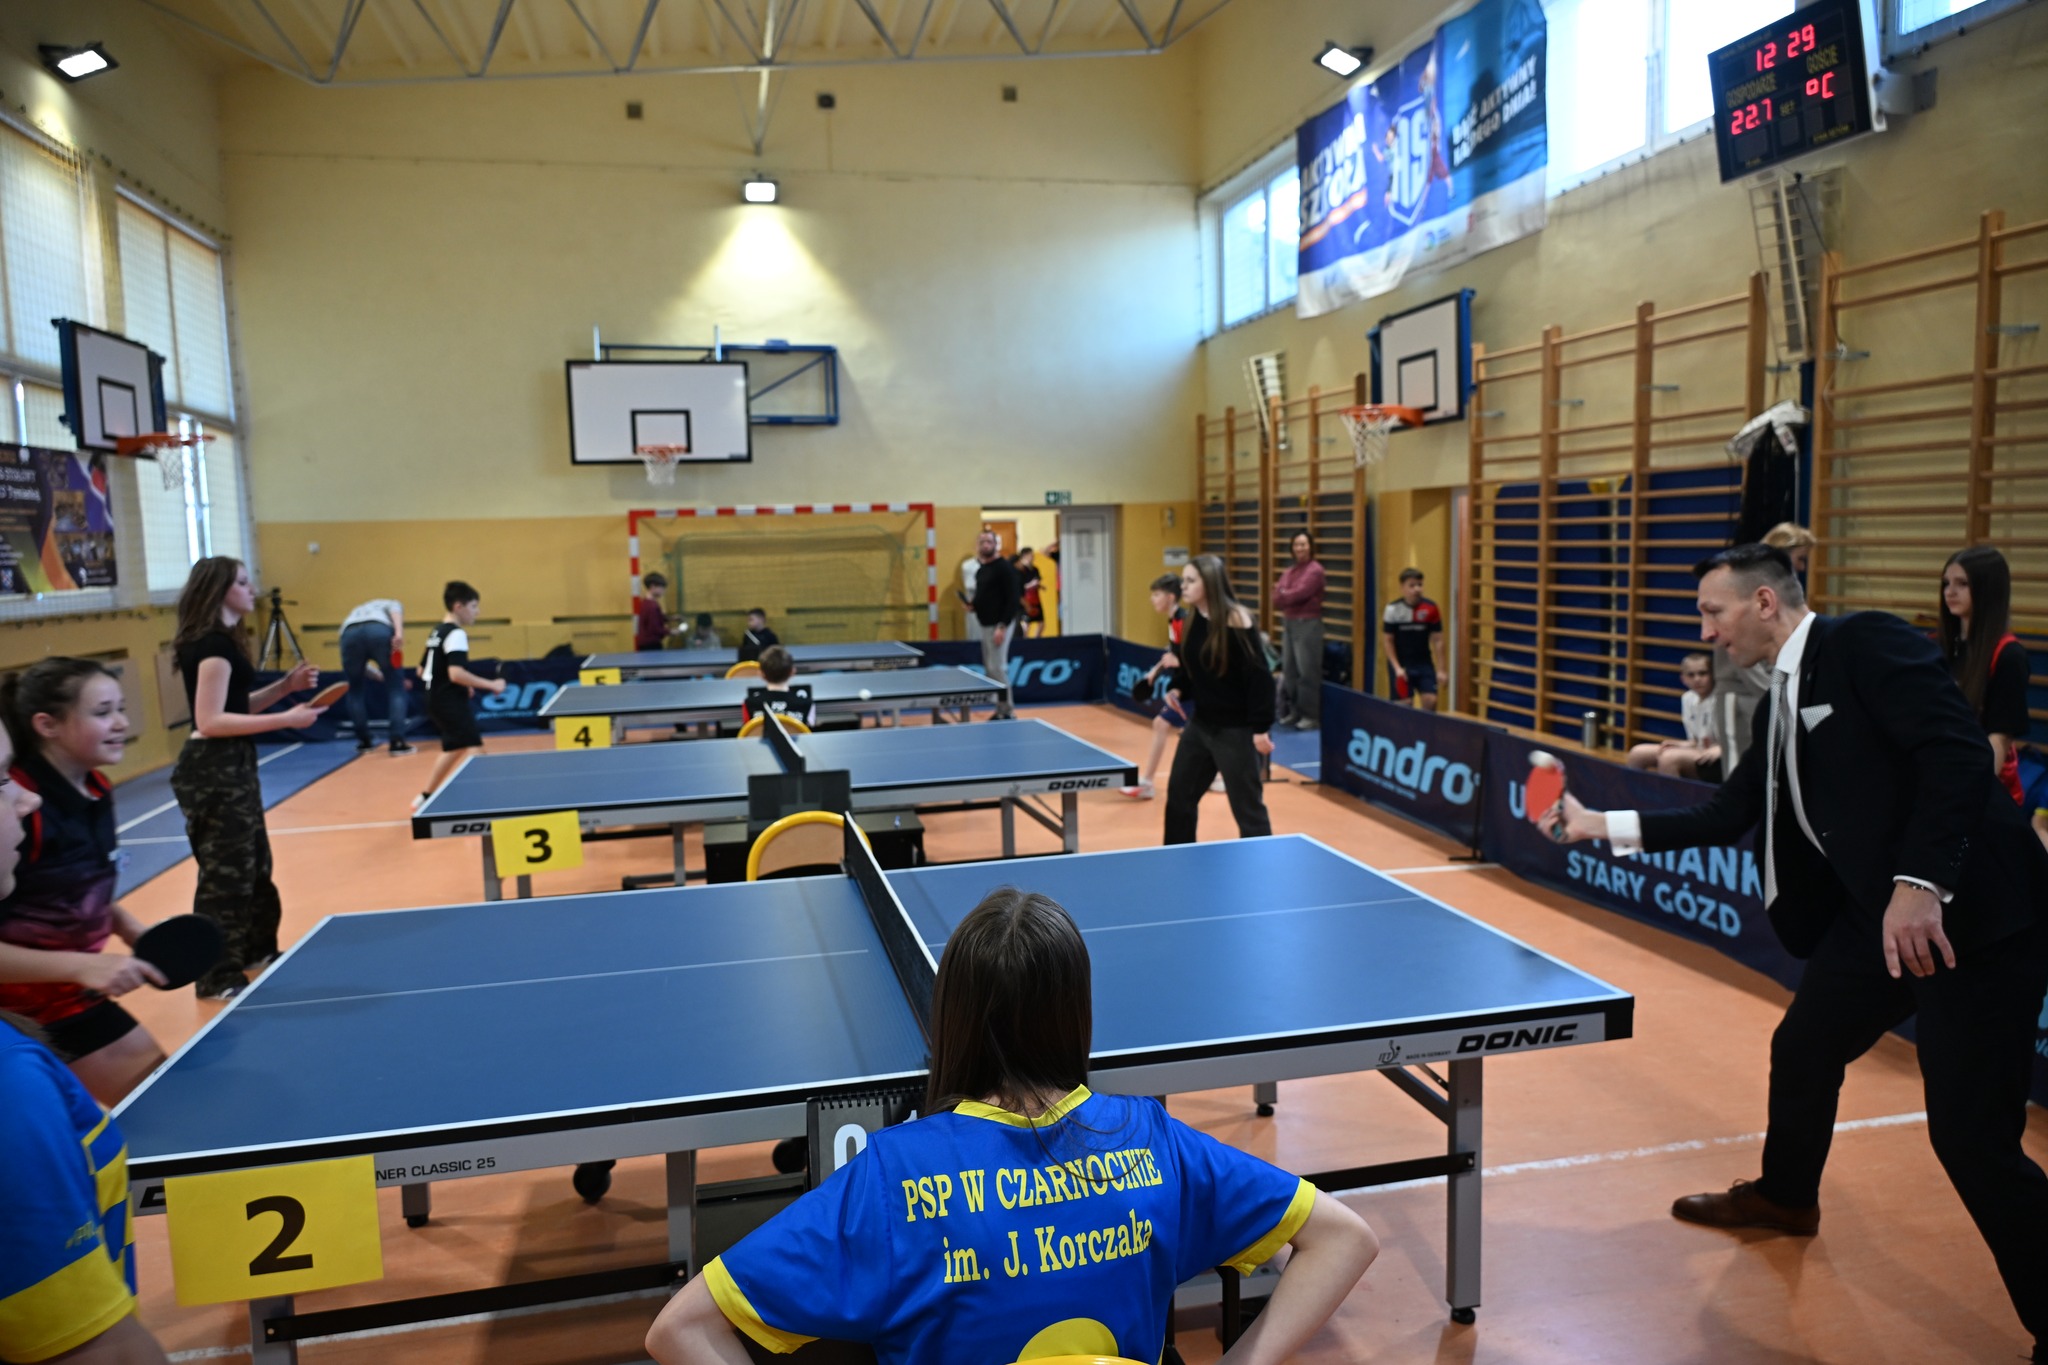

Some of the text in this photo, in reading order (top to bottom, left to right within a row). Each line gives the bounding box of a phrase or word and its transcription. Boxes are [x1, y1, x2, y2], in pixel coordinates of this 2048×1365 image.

[1756, 42, 1777, 71] 12
[1787, 24, 1816, 58] 29
[574, 726, 593, 747] 4
[1048, 777, 1109, 791] DONIC
[1347, 728, 1474, 806] andro
[524, 829, 553, 864] 3
[1567, 849, 1741, 937] STARY GÓZD
[1456, 1023, 1578, 1054] DONIC
[376, 1157, 496, 1181] NER CLASSIC 25
[901, 1147, 1163, 1222] PSP W CZARNOCINIE
[246, 1195, 313, 1277] 2
[943, 1208, 1153, 1283] im. J. Korczaka
